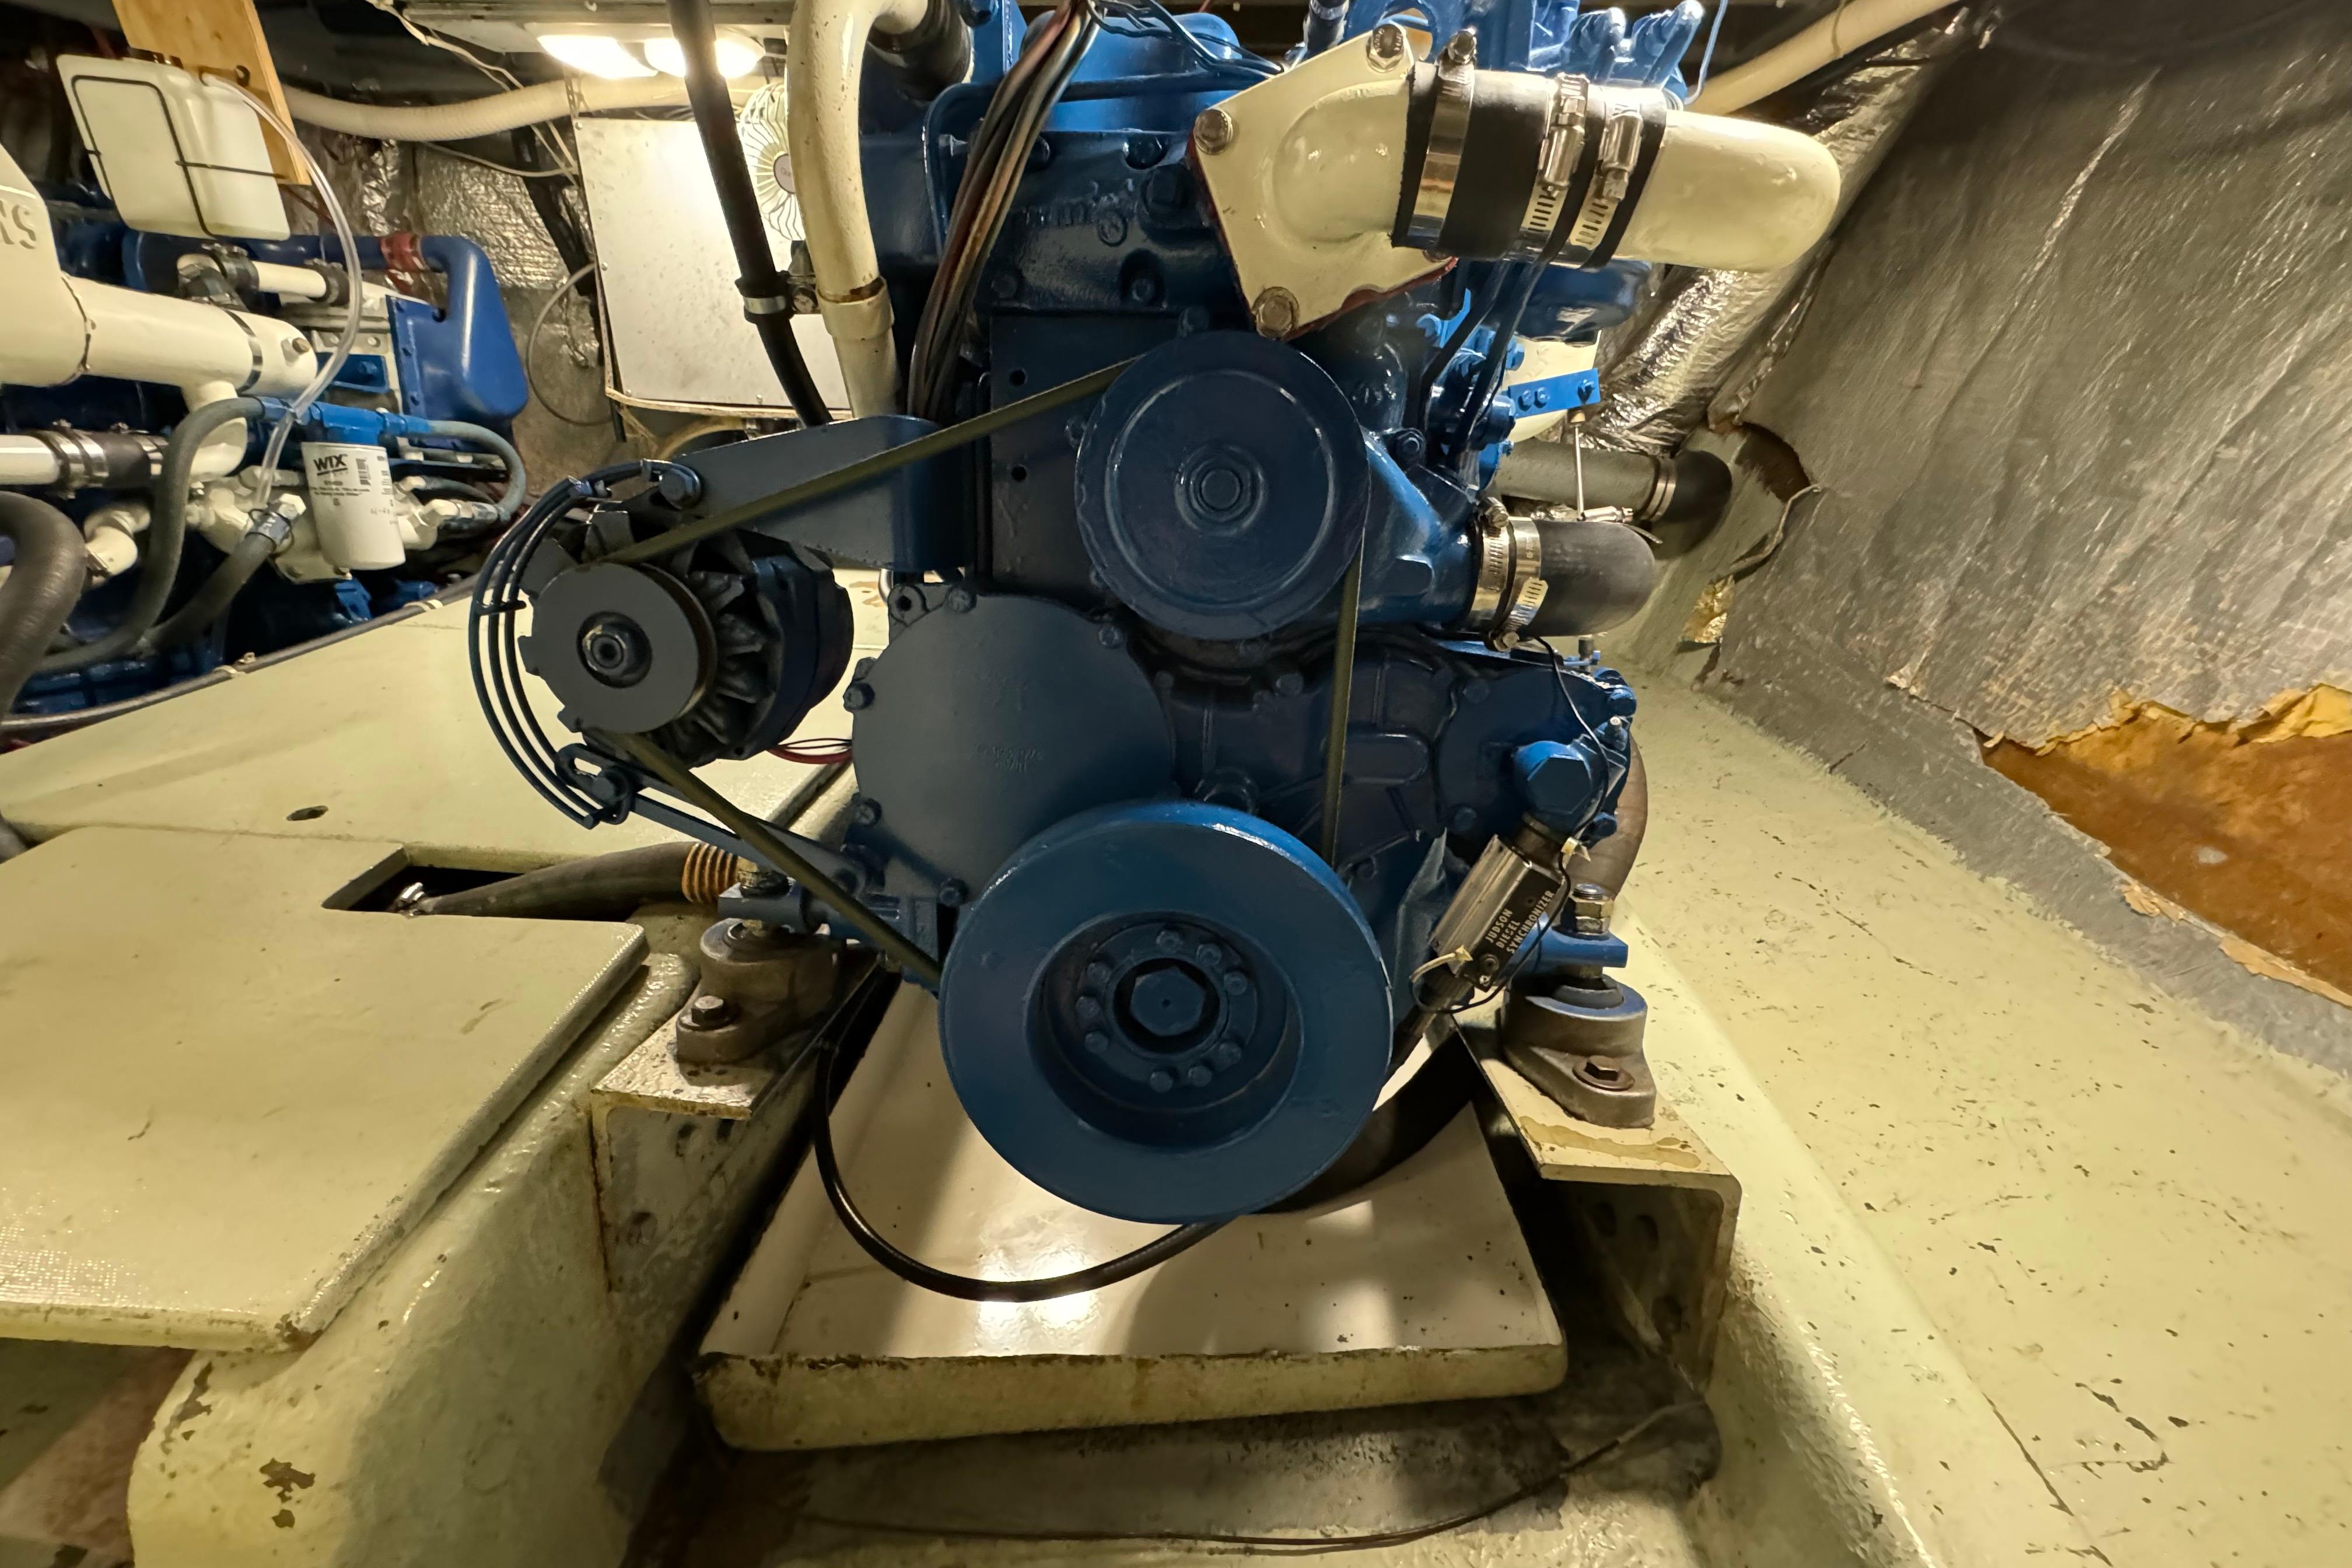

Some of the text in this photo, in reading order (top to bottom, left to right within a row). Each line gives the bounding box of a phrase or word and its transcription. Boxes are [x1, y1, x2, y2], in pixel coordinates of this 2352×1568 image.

[314, 454, 347, 471] WIX
[1485, 908, 1513, 943] JUDSON
[1495, 920, 1521, 949] DIESEL
[1506, 890, 1555, 954] SYNCHRONIZER
